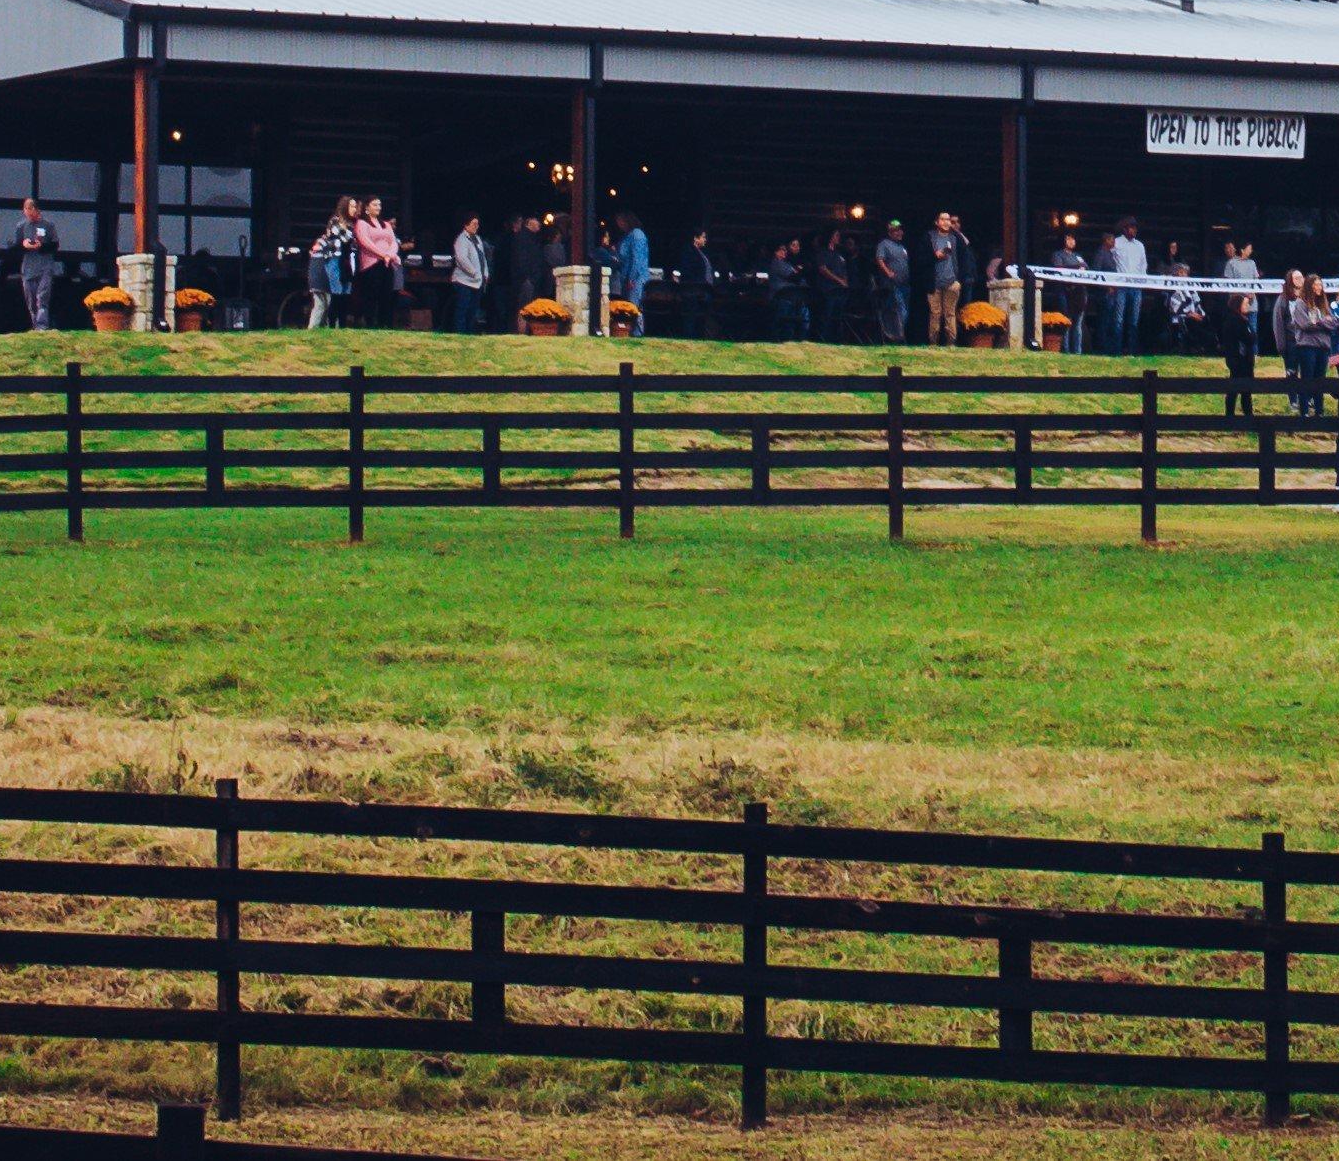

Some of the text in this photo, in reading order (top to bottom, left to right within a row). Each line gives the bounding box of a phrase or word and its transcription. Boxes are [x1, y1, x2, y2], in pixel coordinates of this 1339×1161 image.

[1149, 113, 1304, 150] OPEN TO THE PUBLIC!
